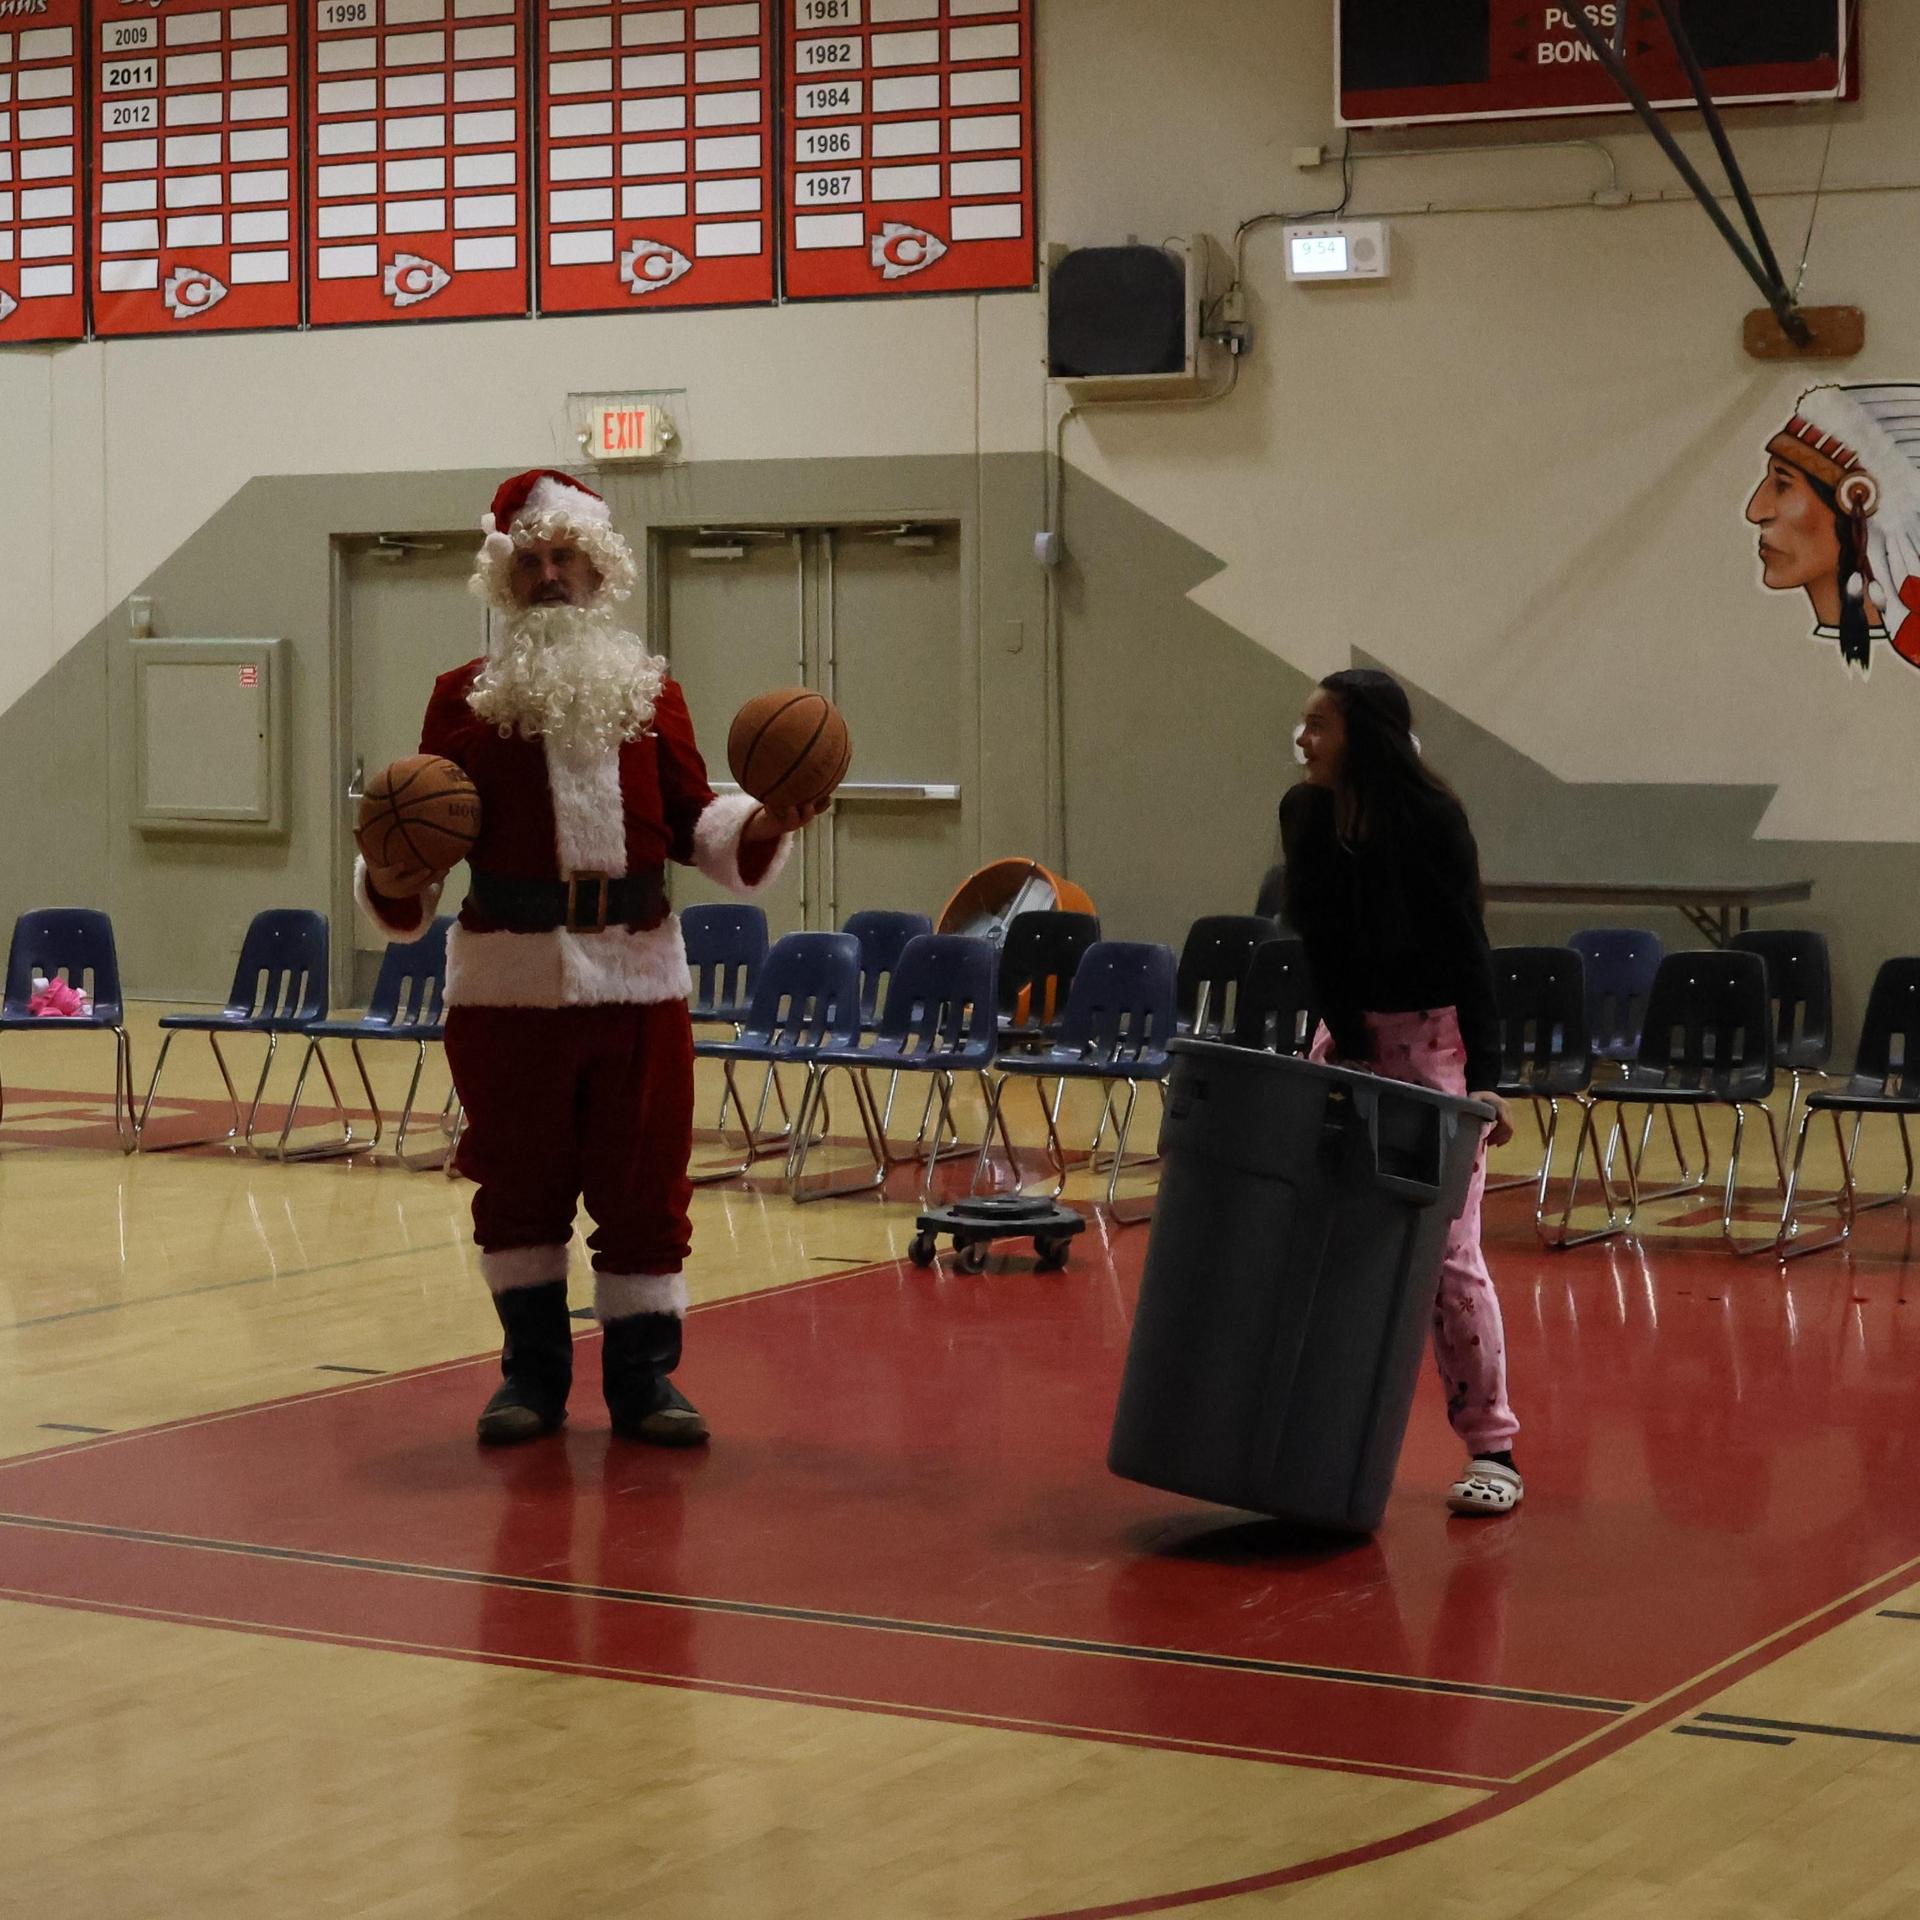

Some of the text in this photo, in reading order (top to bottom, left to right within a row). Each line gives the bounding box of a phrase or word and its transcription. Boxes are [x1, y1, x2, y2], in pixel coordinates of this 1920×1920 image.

[326, 3, 366, 23] 1998
[805, 0, 849, 20] 1981
[115, 27, 148, 46] 2009
[806, 44, 851, 65] 1982
[1538, 38, 1627, 64] BON
[109, 66, 152, 86] 2011
[806, 87, 850, 108] 1984
[113, 105, 150, 125] 2012
[806, 133, 850, 154] 1986
[806, 176, 851, 197] 1987
[884, 233, 927, 267] C
[632, 249, 673, 282] C
[395, 264, 433, 294] C
[175, 277, 211, 307] C
[603, 411, 645, 450] EXIT
